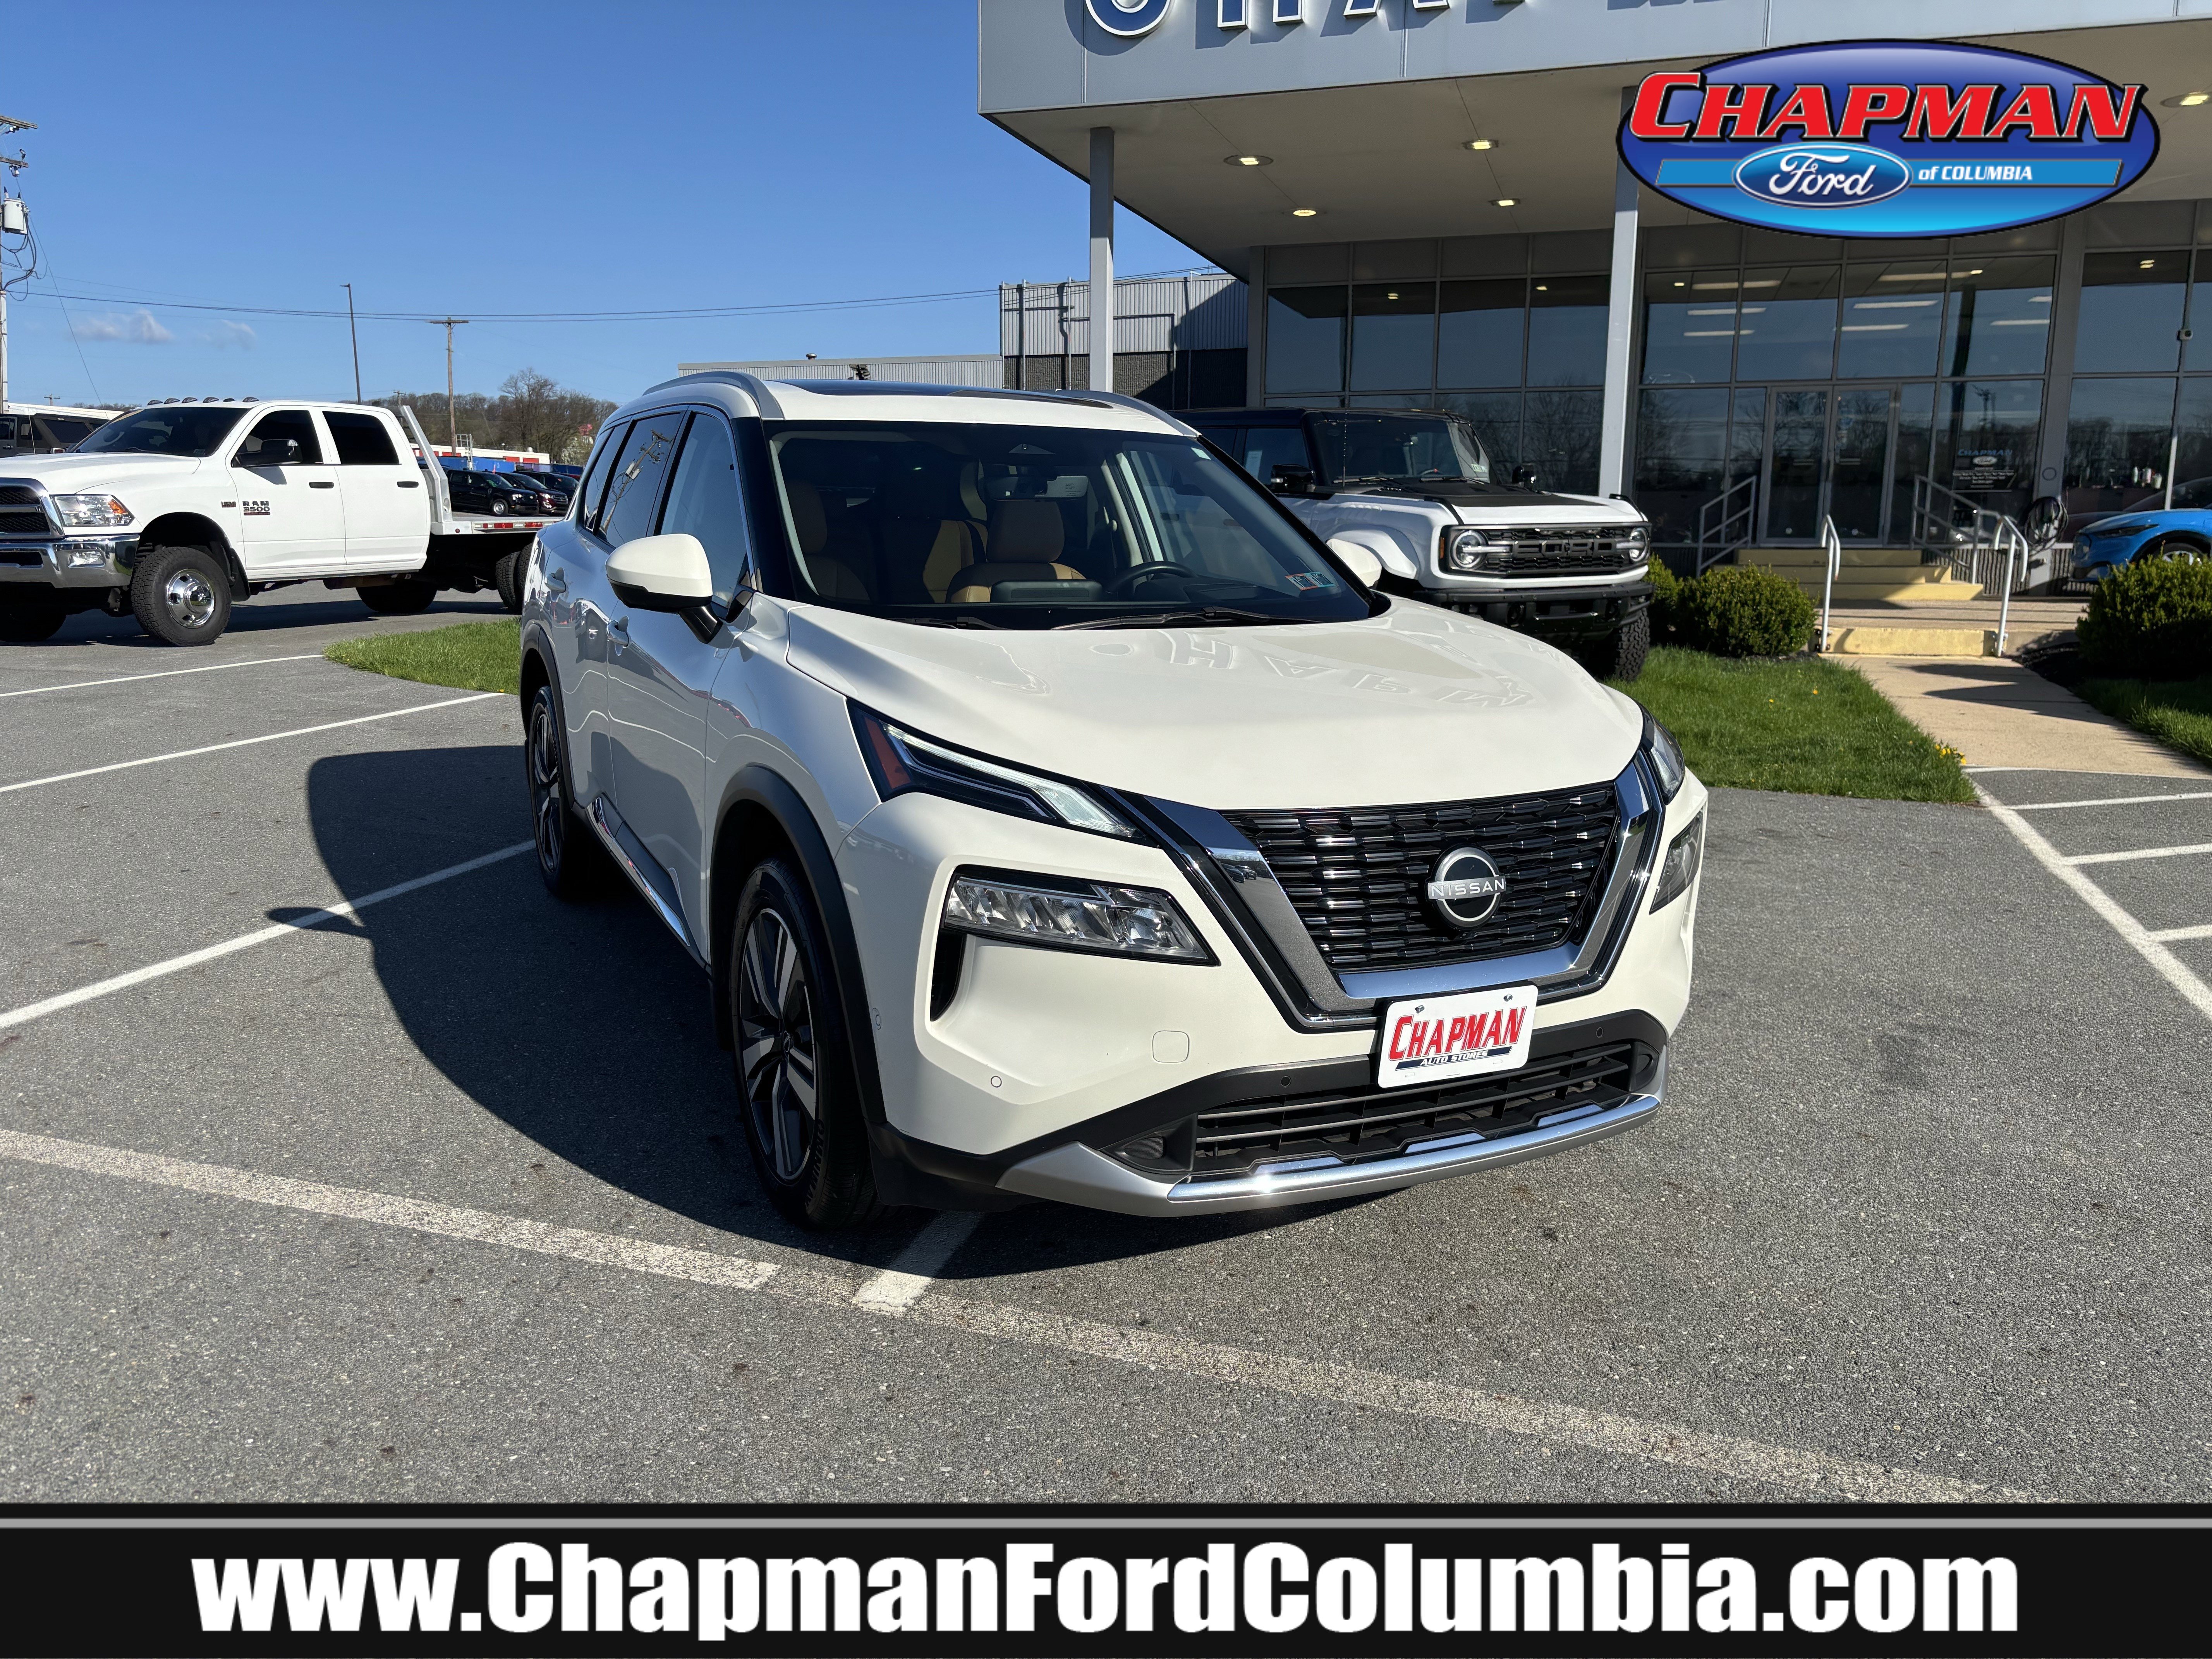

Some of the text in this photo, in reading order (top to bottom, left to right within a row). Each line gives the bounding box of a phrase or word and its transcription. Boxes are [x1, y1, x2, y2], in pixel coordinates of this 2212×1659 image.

[1513, 539, 1617, 558] FORD
[1431, 878, 1505, 897] NISSAN
[1388, 1006, 1527, 1061] CHAPMAN
[1419, 1050, 1489, 1066] AUTO STORES
